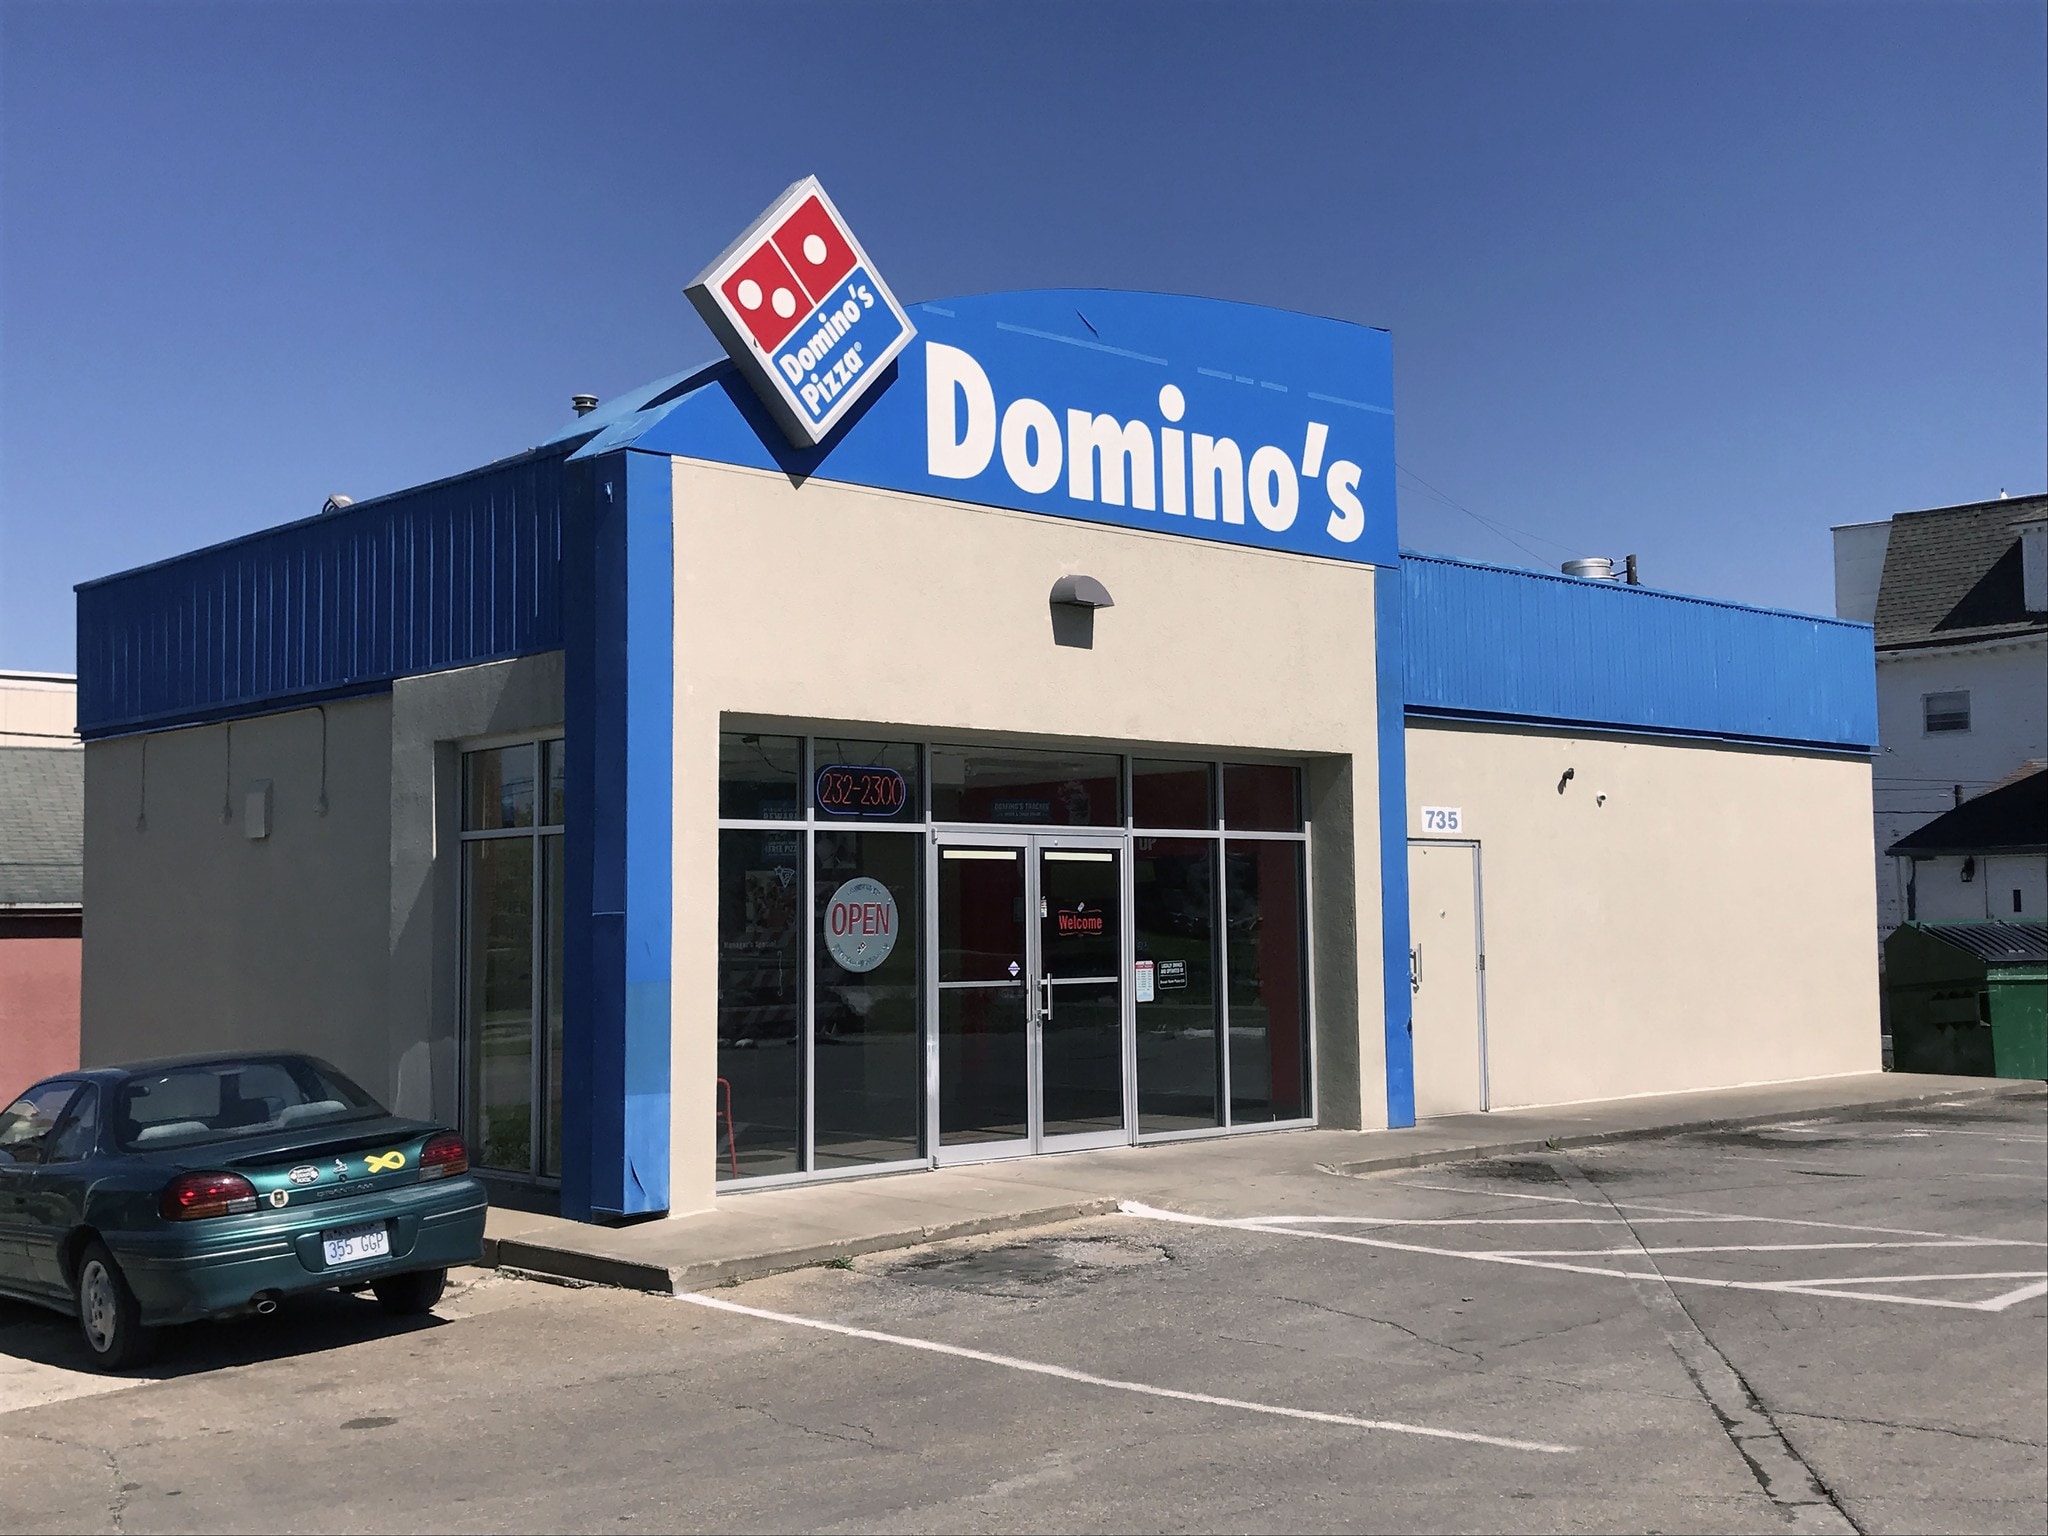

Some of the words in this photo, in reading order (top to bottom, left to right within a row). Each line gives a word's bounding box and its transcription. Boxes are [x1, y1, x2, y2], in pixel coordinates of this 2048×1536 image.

[779, 283, 874, 386] Domino's
[925, 340, 1365, 543] Domino's
[822, 773, 903, 805] 232-2300
[1425, 810, 1458, 830] 735
[831, 901, 891, 936] OPEN
[1058, 914, 1103, 930] Welcome
[328, 1239, 353, 1259] 355
[361, 1232, 383, 1252] GGP
